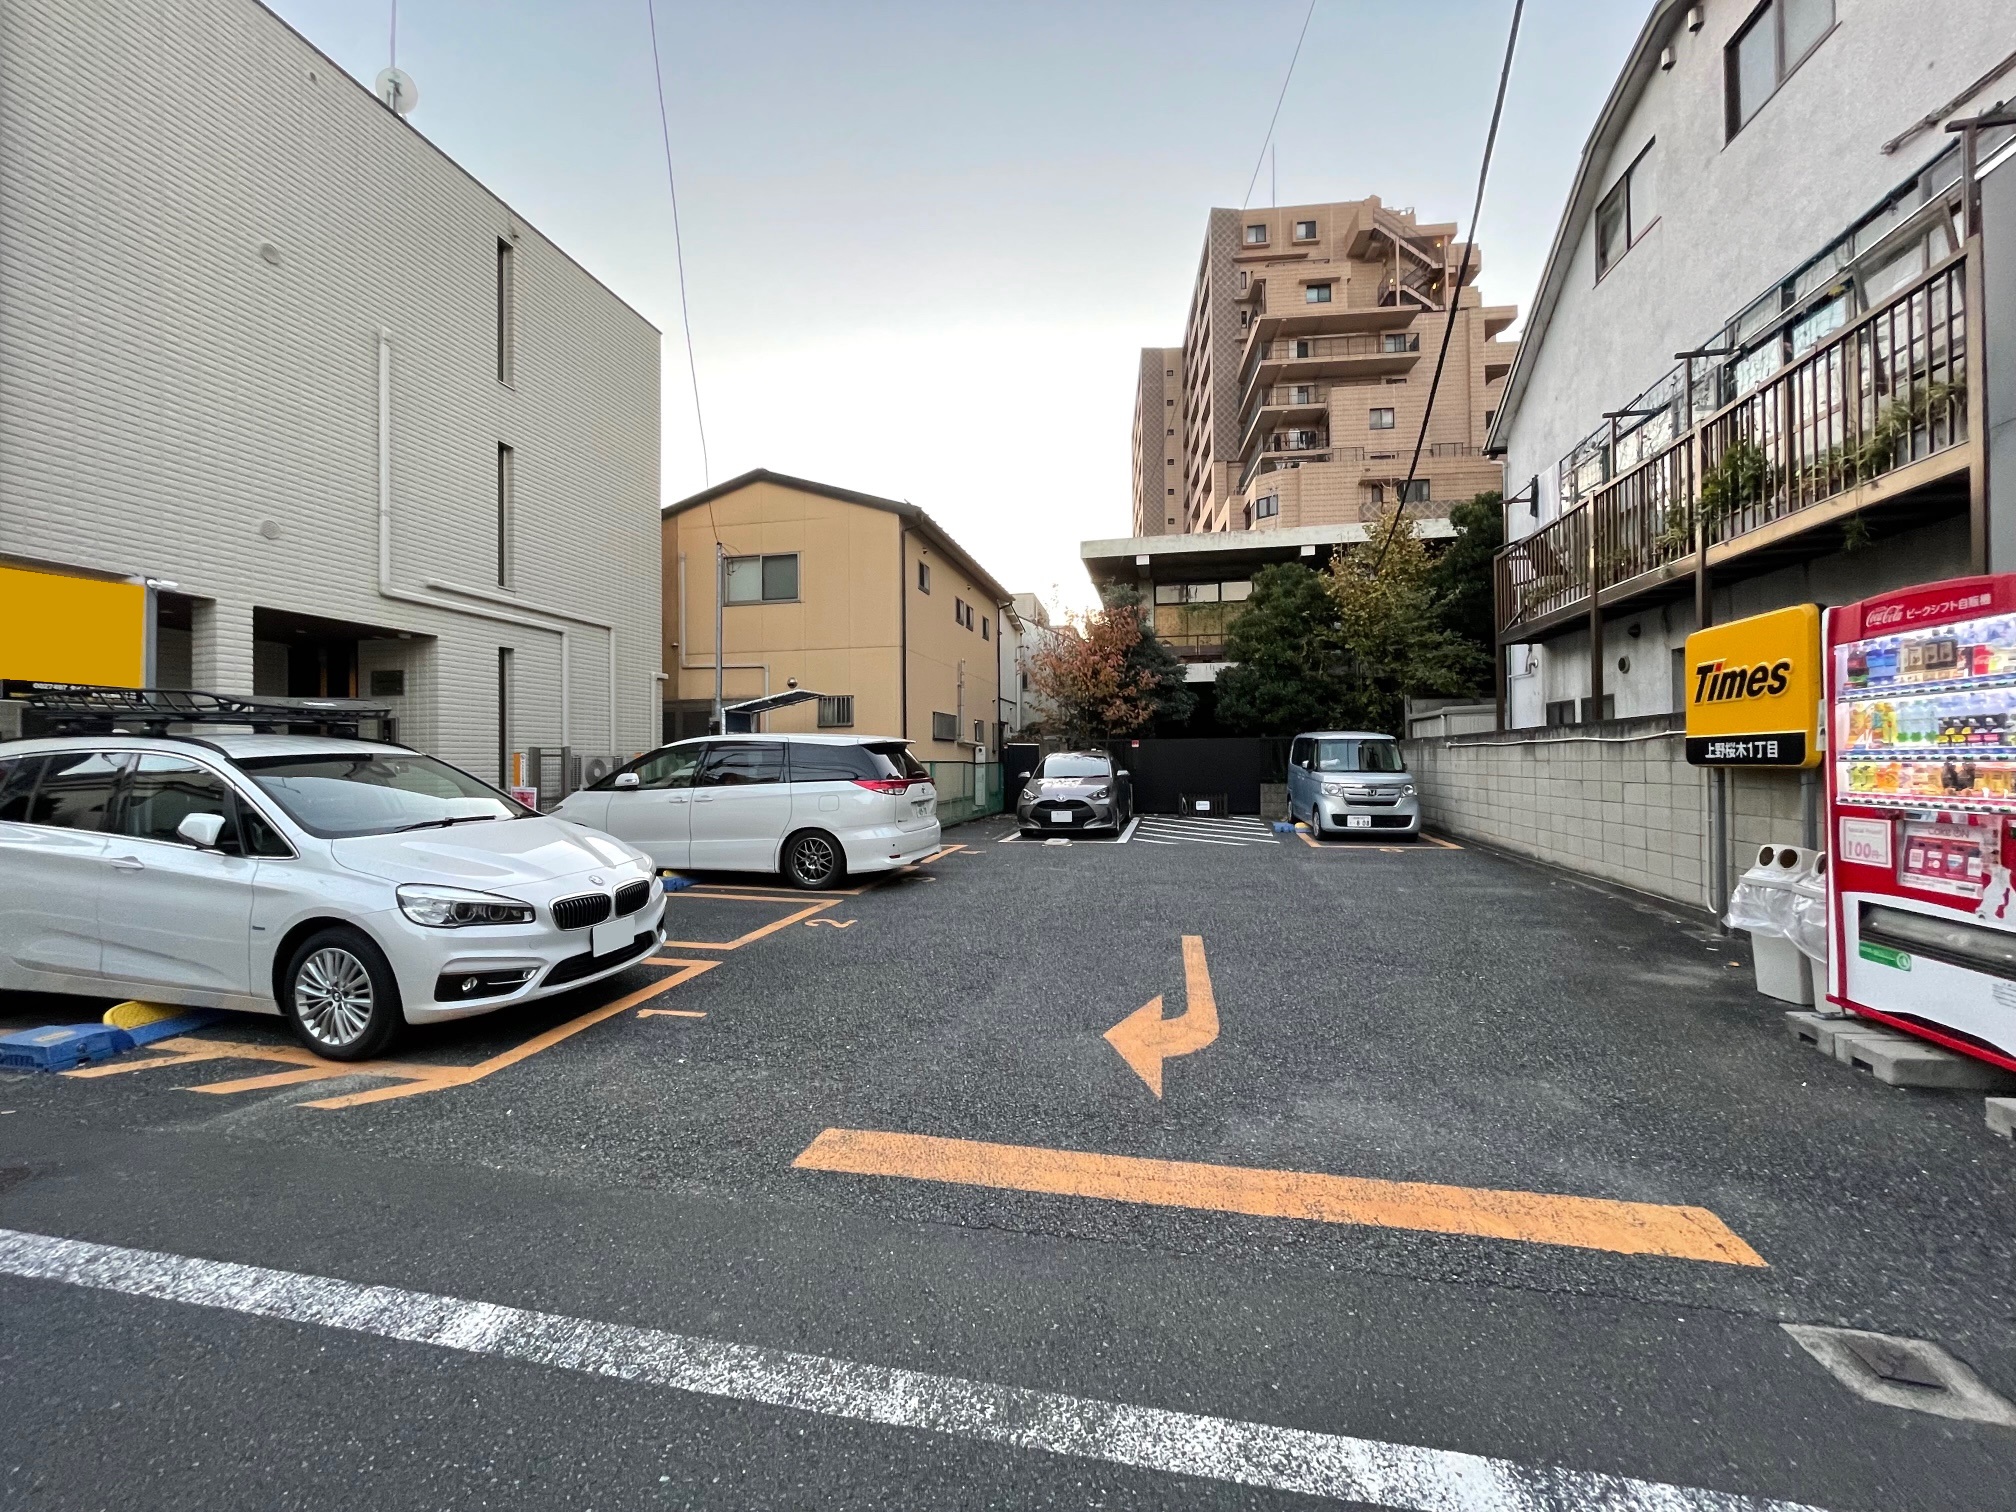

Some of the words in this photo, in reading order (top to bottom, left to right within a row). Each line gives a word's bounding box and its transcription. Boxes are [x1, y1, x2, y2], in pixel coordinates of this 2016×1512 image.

[1906, 593, 1992, 620] ピークシフト自販機
[1694, 659, 1791, 705] Times
[1705, 740, 1779, 759] 上野桜木1丁目
